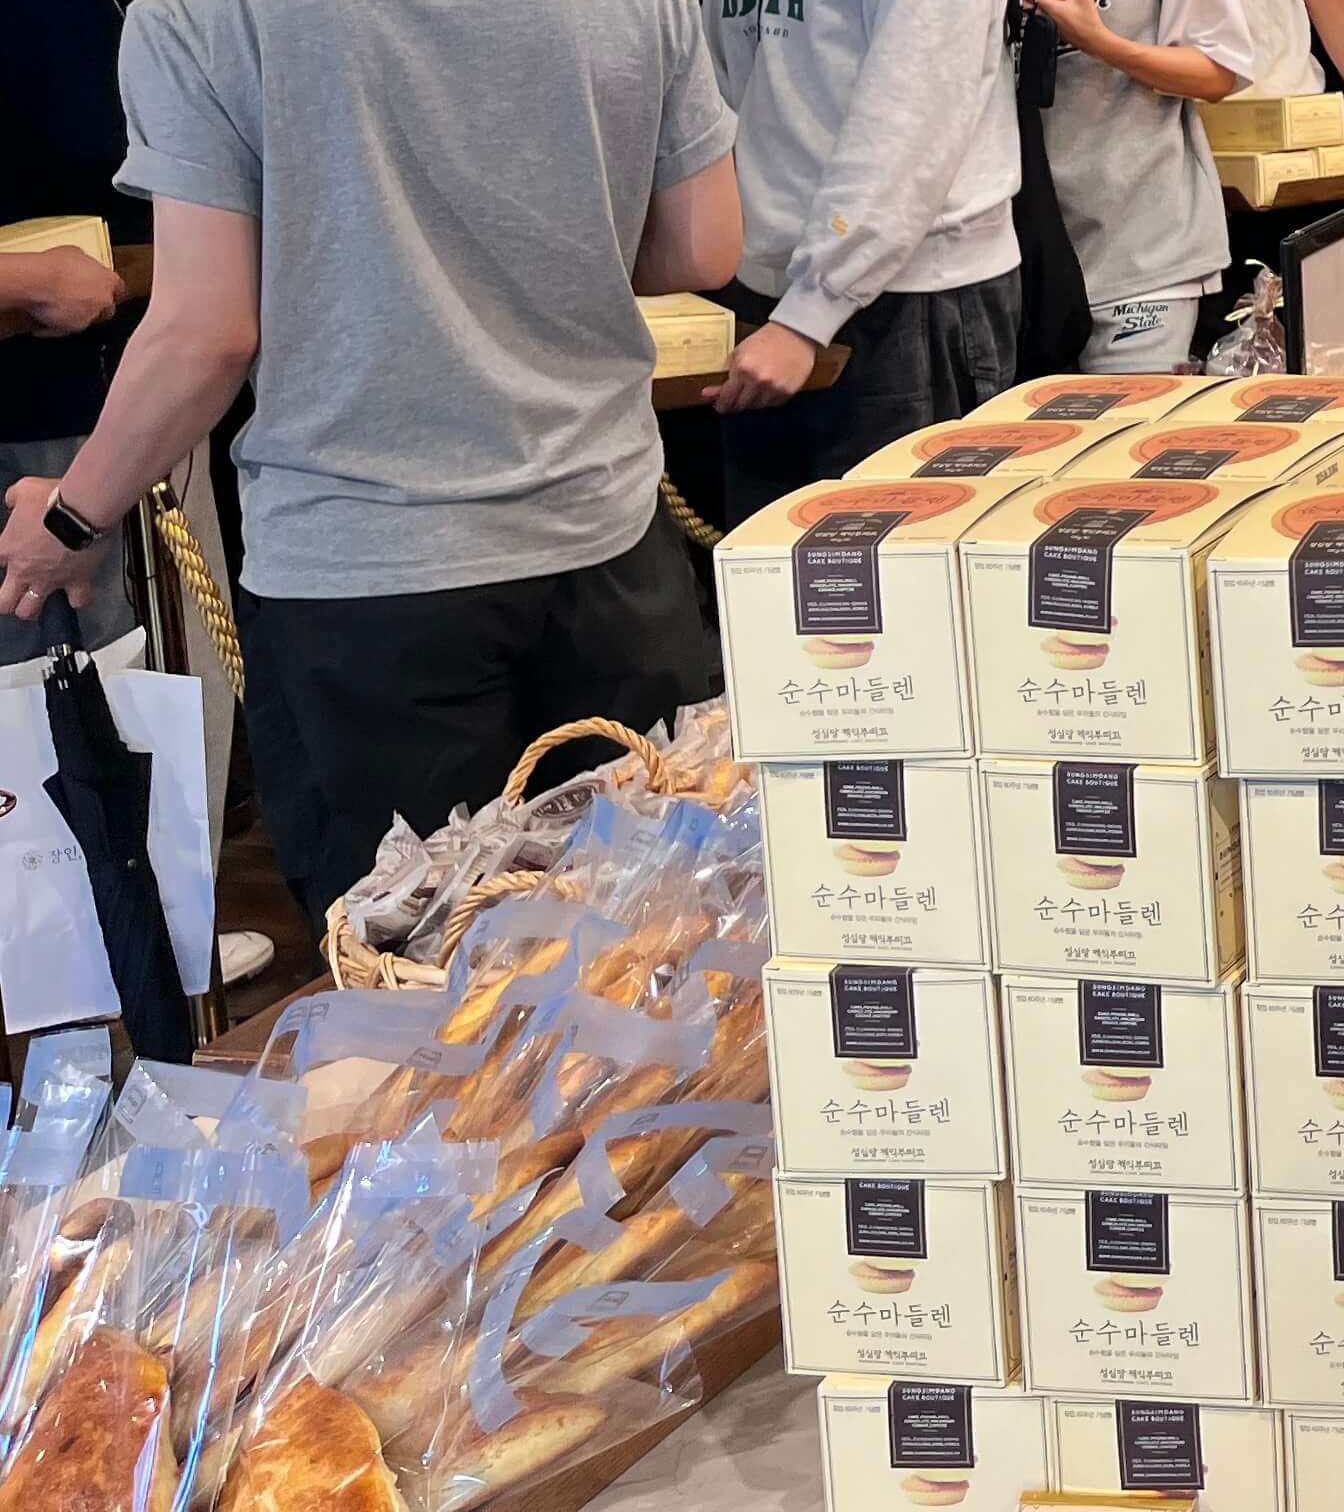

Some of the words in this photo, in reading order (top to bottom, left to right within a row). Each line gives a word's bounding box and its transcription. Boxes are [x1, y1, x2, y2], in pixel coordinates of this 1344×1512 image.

[1112, 302, 1168, 318] Michigan
[1122, 315, 1161, 330] State
[778, 676, 915, 705] 순수마들렌
[1017, 678, 1147, 705] 순수마들렌
[811, 884, 937, 911] 순수마들렌
[1034, 896, 1162, 926] 순수마들렌
[820, 1097, 951, 1124] 순수마들렌
[1058, 1109, 1190, 1136] 순수마들렌
[827, 1300, 953, 1328] 순수마들렌
[1069, 1318, 1200, 1347] 순수마들렌
